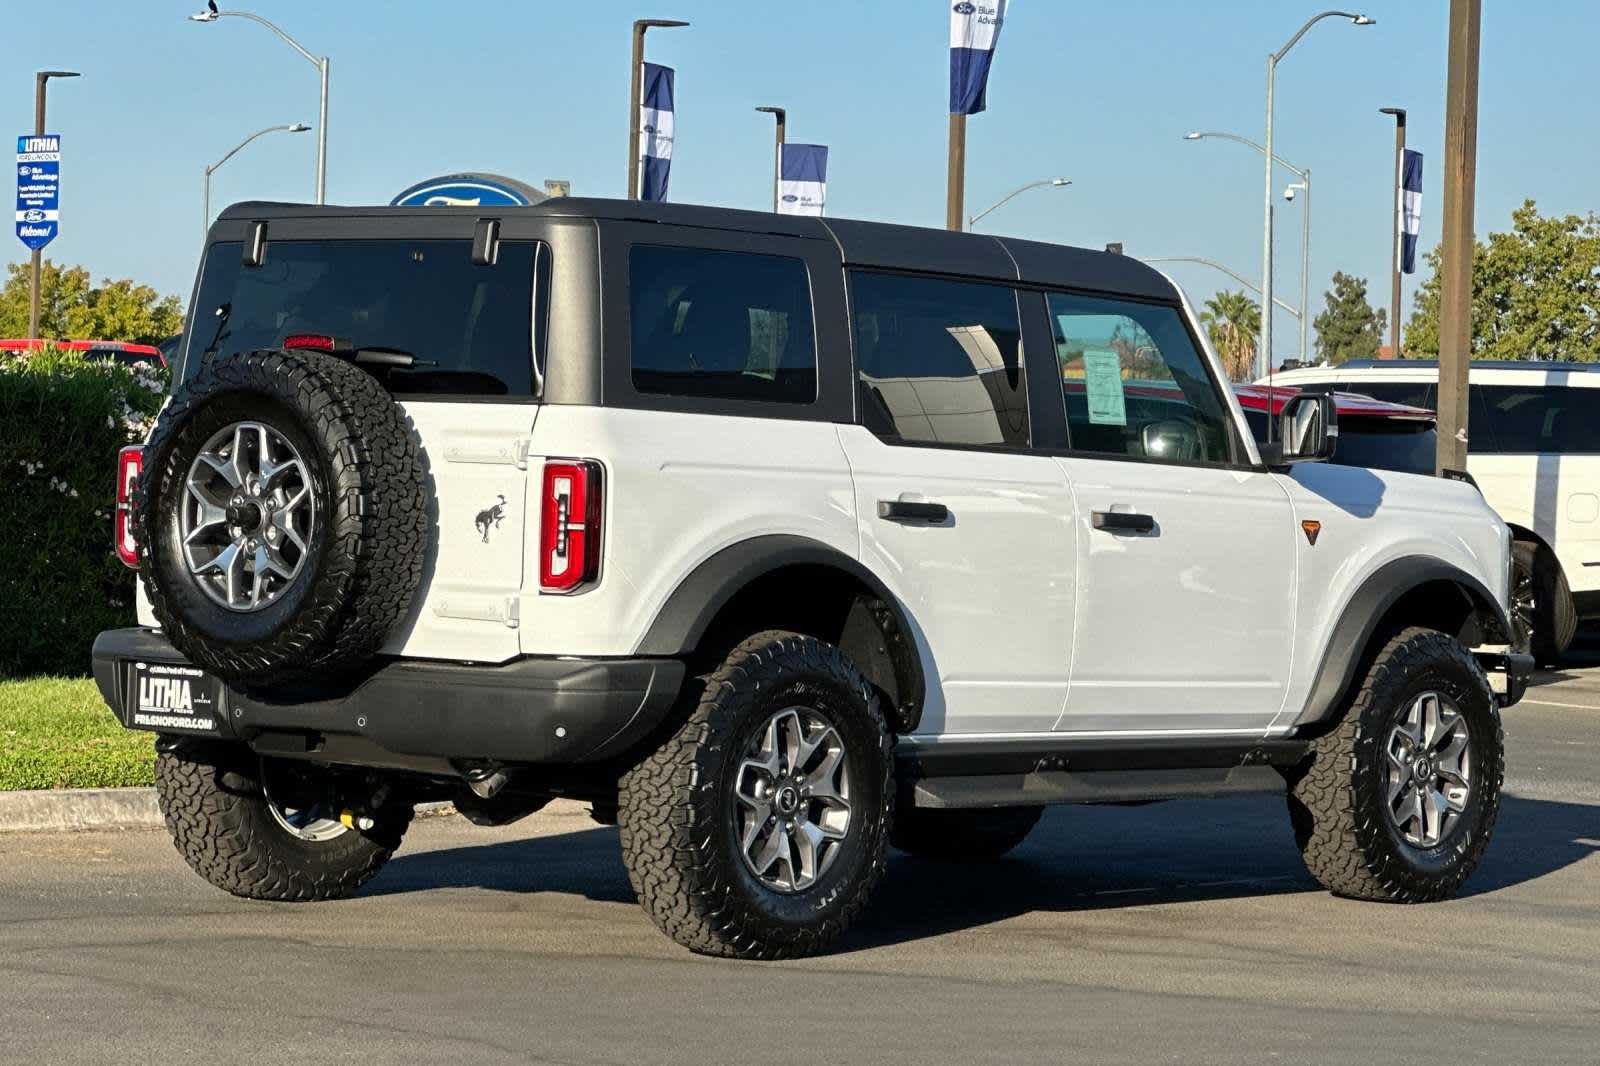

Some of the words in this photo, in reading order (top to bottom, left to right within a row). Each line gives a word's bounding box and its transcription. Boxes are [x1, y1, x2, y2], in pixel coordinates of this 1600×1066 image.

[978, 6, 995, 15] Blue
[25, 138, 58, 152] LITHIA
[20, 225, 52, 237] Welcome!
[140, 677, 192, 710] LITHIA
[134, 714, 213, 730] FRESNOFORD.COM
